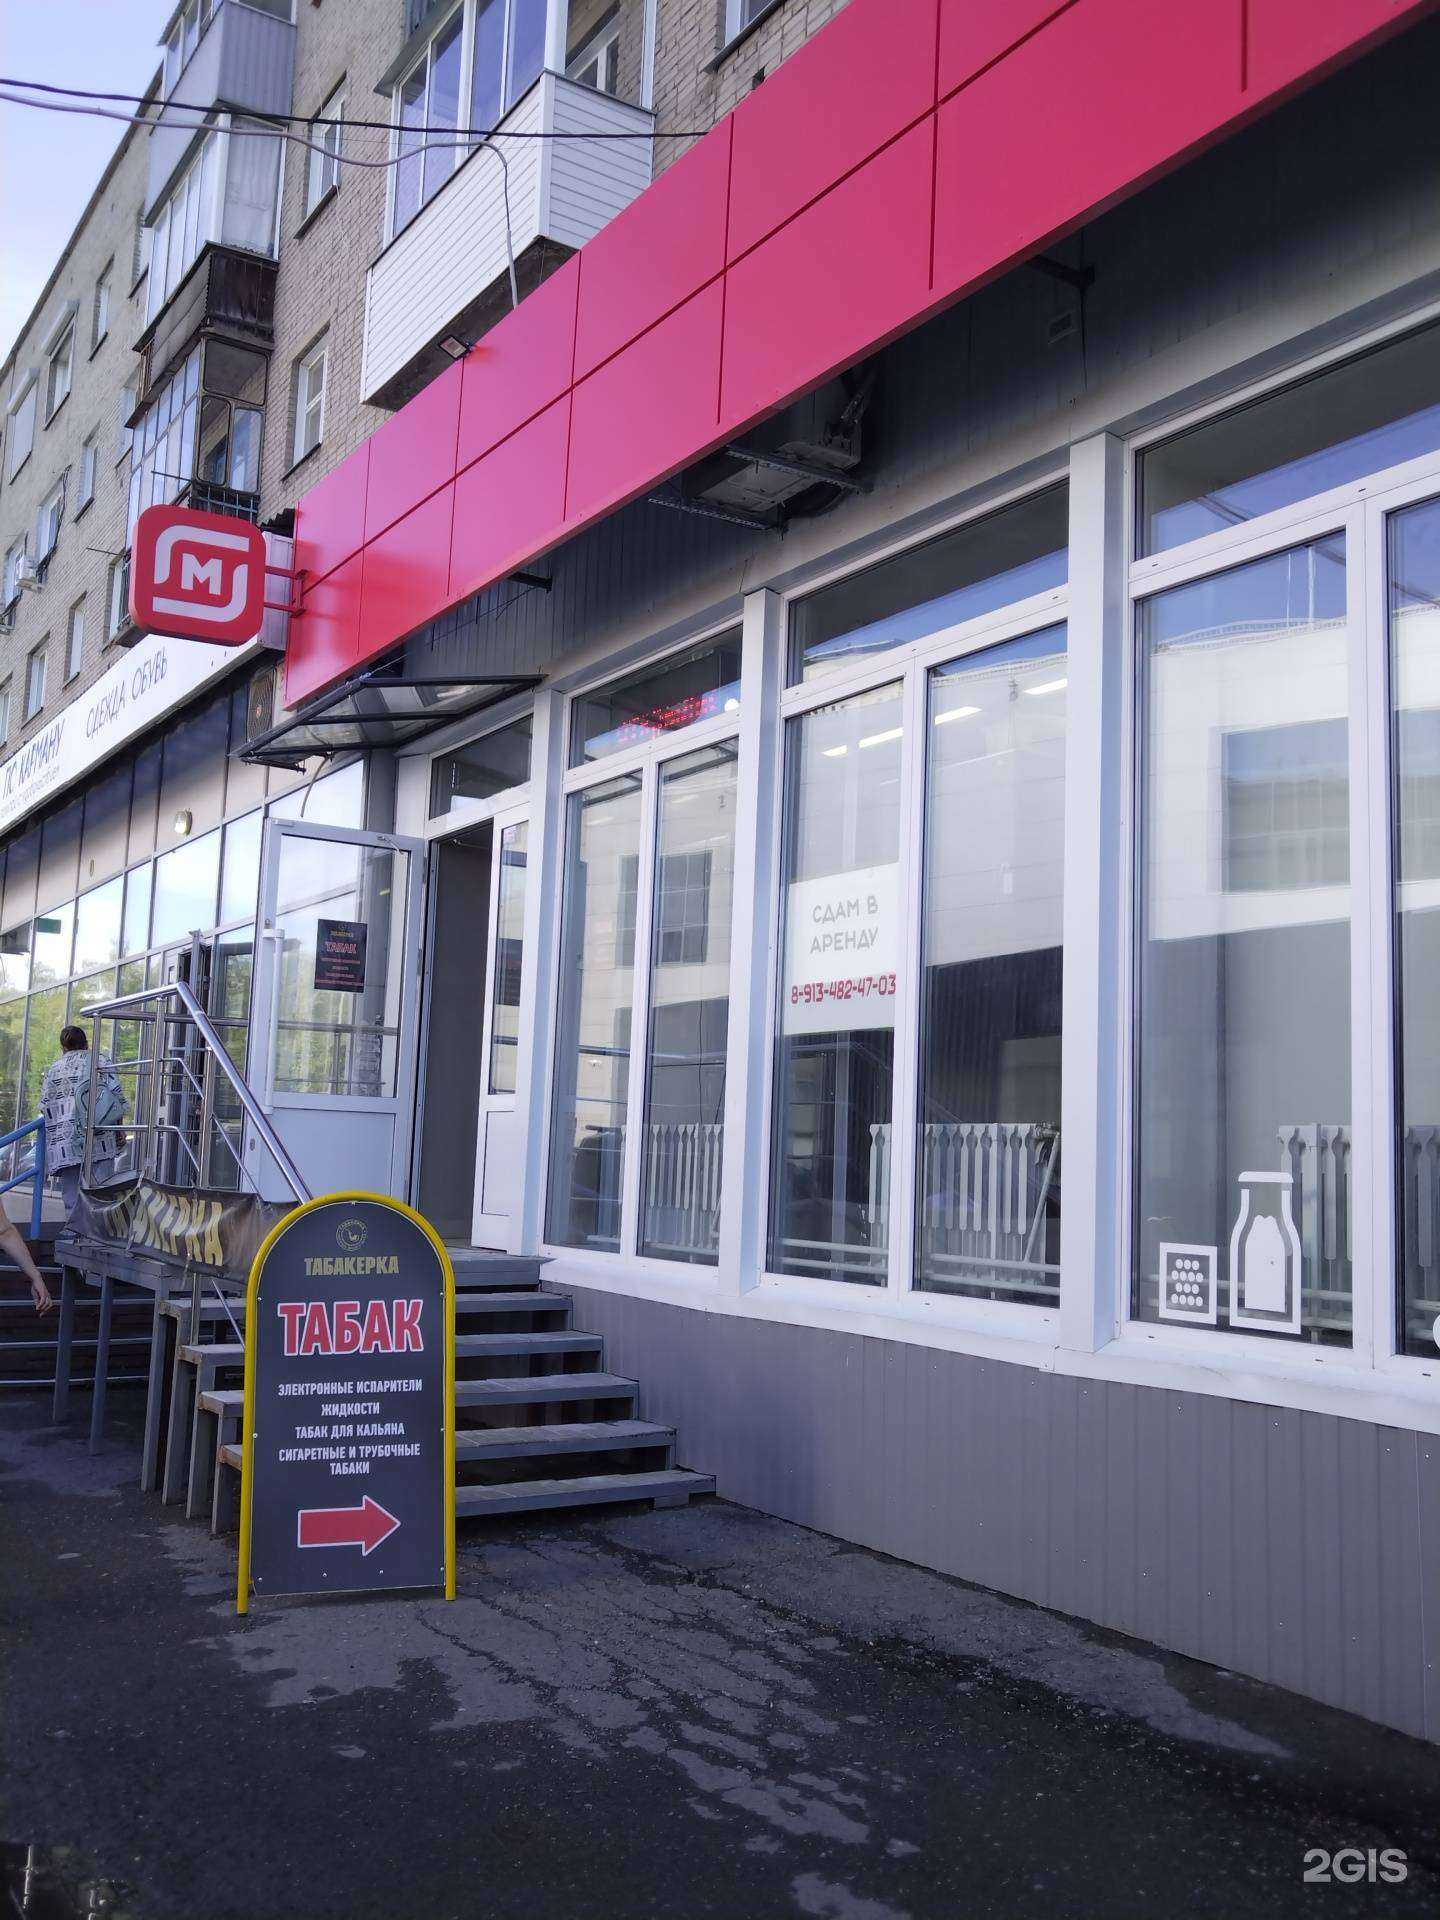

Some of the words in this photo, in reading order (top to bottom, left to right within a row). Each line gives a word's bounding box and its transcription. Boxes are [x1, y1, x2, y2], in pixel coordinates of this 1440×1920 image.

[132, 647, 168, 701] ОБУВЬ
[812, 899, 860, 924] СДАМ
[867, 895, 879, 915] В
[810, 927, 879, 954] АРЕНДУ
[790, 974, 897, 1005] 8-913-482-47-03
[303, 1255, 400, 1277] ТАБАКЕРКА
[277, 1299, 425, 1356] ТАБАК
[278, 1381, 354, 1396] ЭЛЕКТРОННЫЕ
[356, 1379, 423, 1393] ИСПАРИТЕЛИ
[321, 1402, 380, 1418] ЖИДКОСТИ
[295, 1426, 328, 1439] ТАБАК
[330, 1424, 353, 1439] ДЛЯ
[356, 1422, 405, 1436] КАЛЬЯНА
[279, 1446, 346, 1461] СИГАРЕТНЫЕ
[348, 1446, 356, 1459] И
[359, 1443, 421, 1458] ТРУБОЧНЫЕ
[330, 1461, 370, 1475] ТАБАКИ
